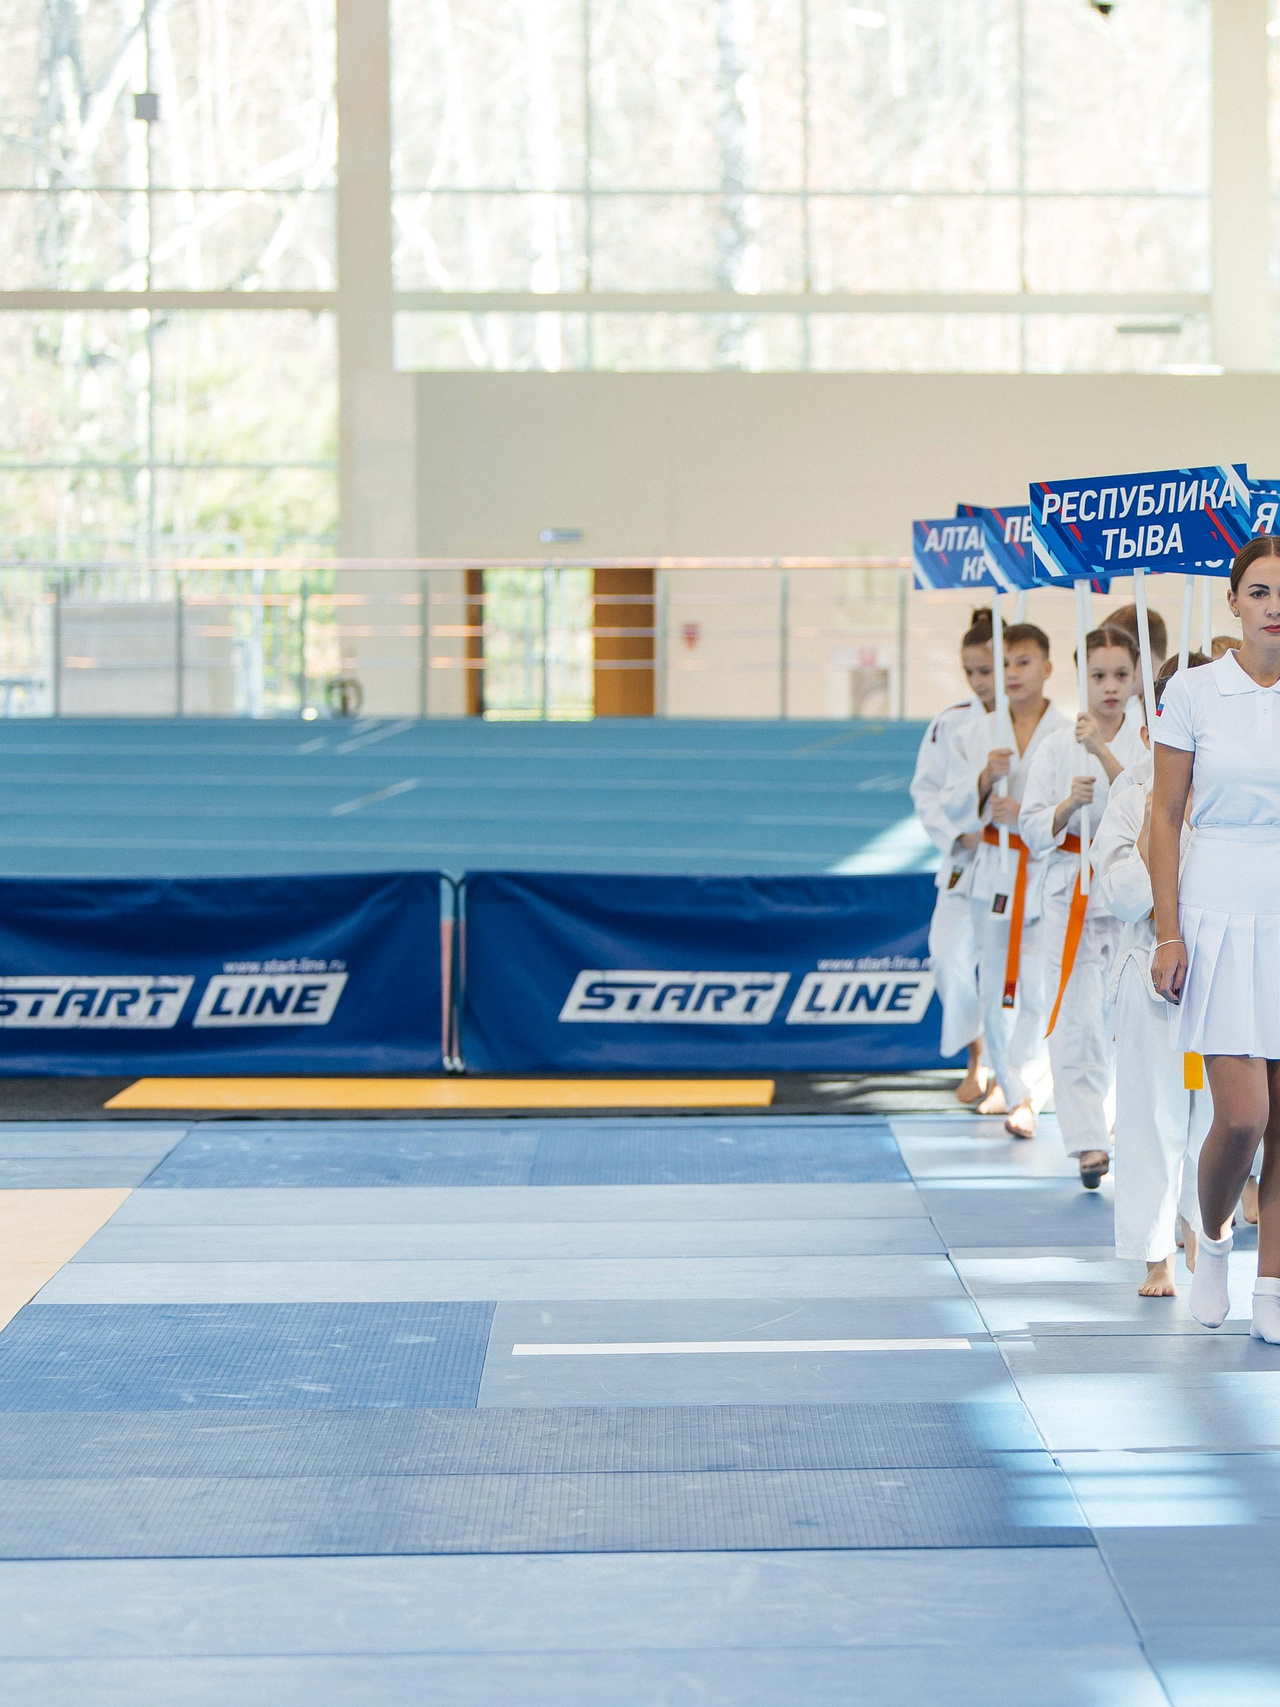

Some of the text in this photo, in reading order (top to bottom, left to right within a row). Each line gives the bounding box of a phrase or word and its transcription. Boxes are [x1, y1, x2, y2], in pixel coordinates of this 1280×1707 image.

[1041, 478, 1237, 526] РЕСПУБЛИКА
[1102, 522, 1184, 561] ТЫВА
[209, 984, 328, 1016] LINE
[577, 982, 920, 1013] START LINE
